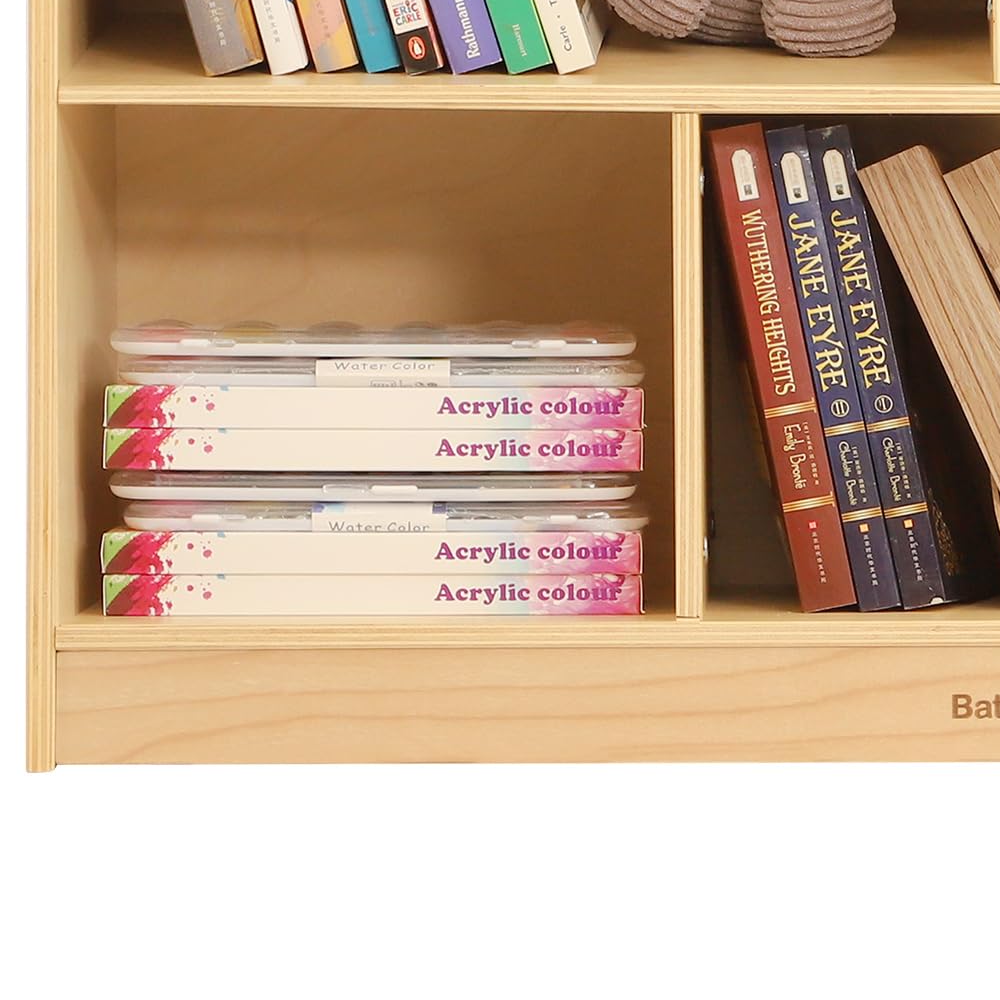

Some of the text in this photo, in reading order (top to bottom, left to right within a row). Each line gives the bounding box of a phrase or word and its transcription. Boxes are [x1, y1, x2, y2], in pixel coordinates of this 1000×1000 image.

[392, 1, 418, 17] ERIC
[395, 11, 421, 26] CARLE
[559, 26, 572, 51] Carle
[788, 213, 827, 297] JANE
[742, 209, 795, 395] WUTHERING HEIGHTS
[831, 210, 890, 387] JANE EYRE
[807, 304, 846, 391] EYRE
[334, 362, 435, 370] Water Color
[437, 397, 624, 418] Acrylic colour
[783, 423, 804, 451] Emily
[435, 439, 622, 460] Acrylic colour
[329, 521, 430, 532] Water Color
[434, 542, 622, 563] Acrylic colour
[434, 583, 622, 604] Acrylic colour
